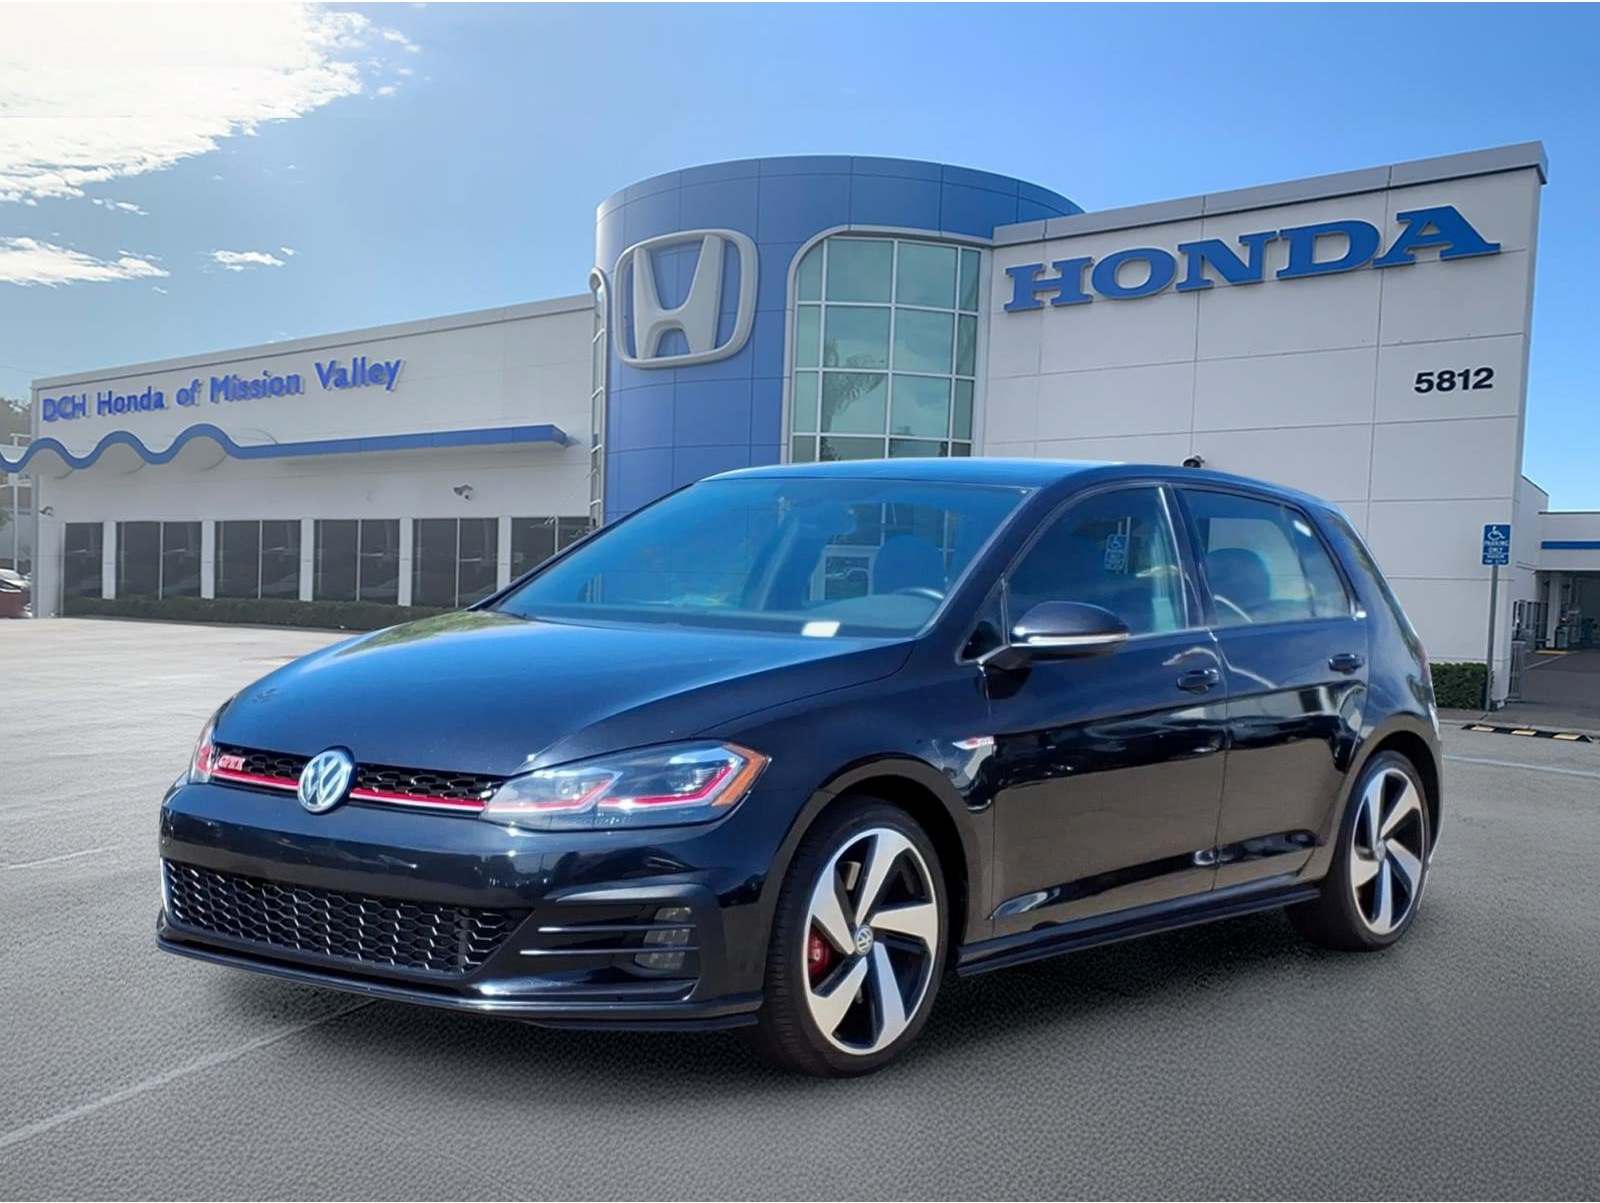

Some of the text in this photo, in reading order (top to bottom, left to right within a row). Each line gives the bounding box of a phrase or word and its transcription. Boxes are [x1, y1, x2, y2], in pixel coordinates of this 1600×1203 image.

[1004, 205, 1502, 312] HONDA
[43, 356, 402, 422] DCH Honda of Mission Valley
[1414, 366, 1494, 393] 5812
